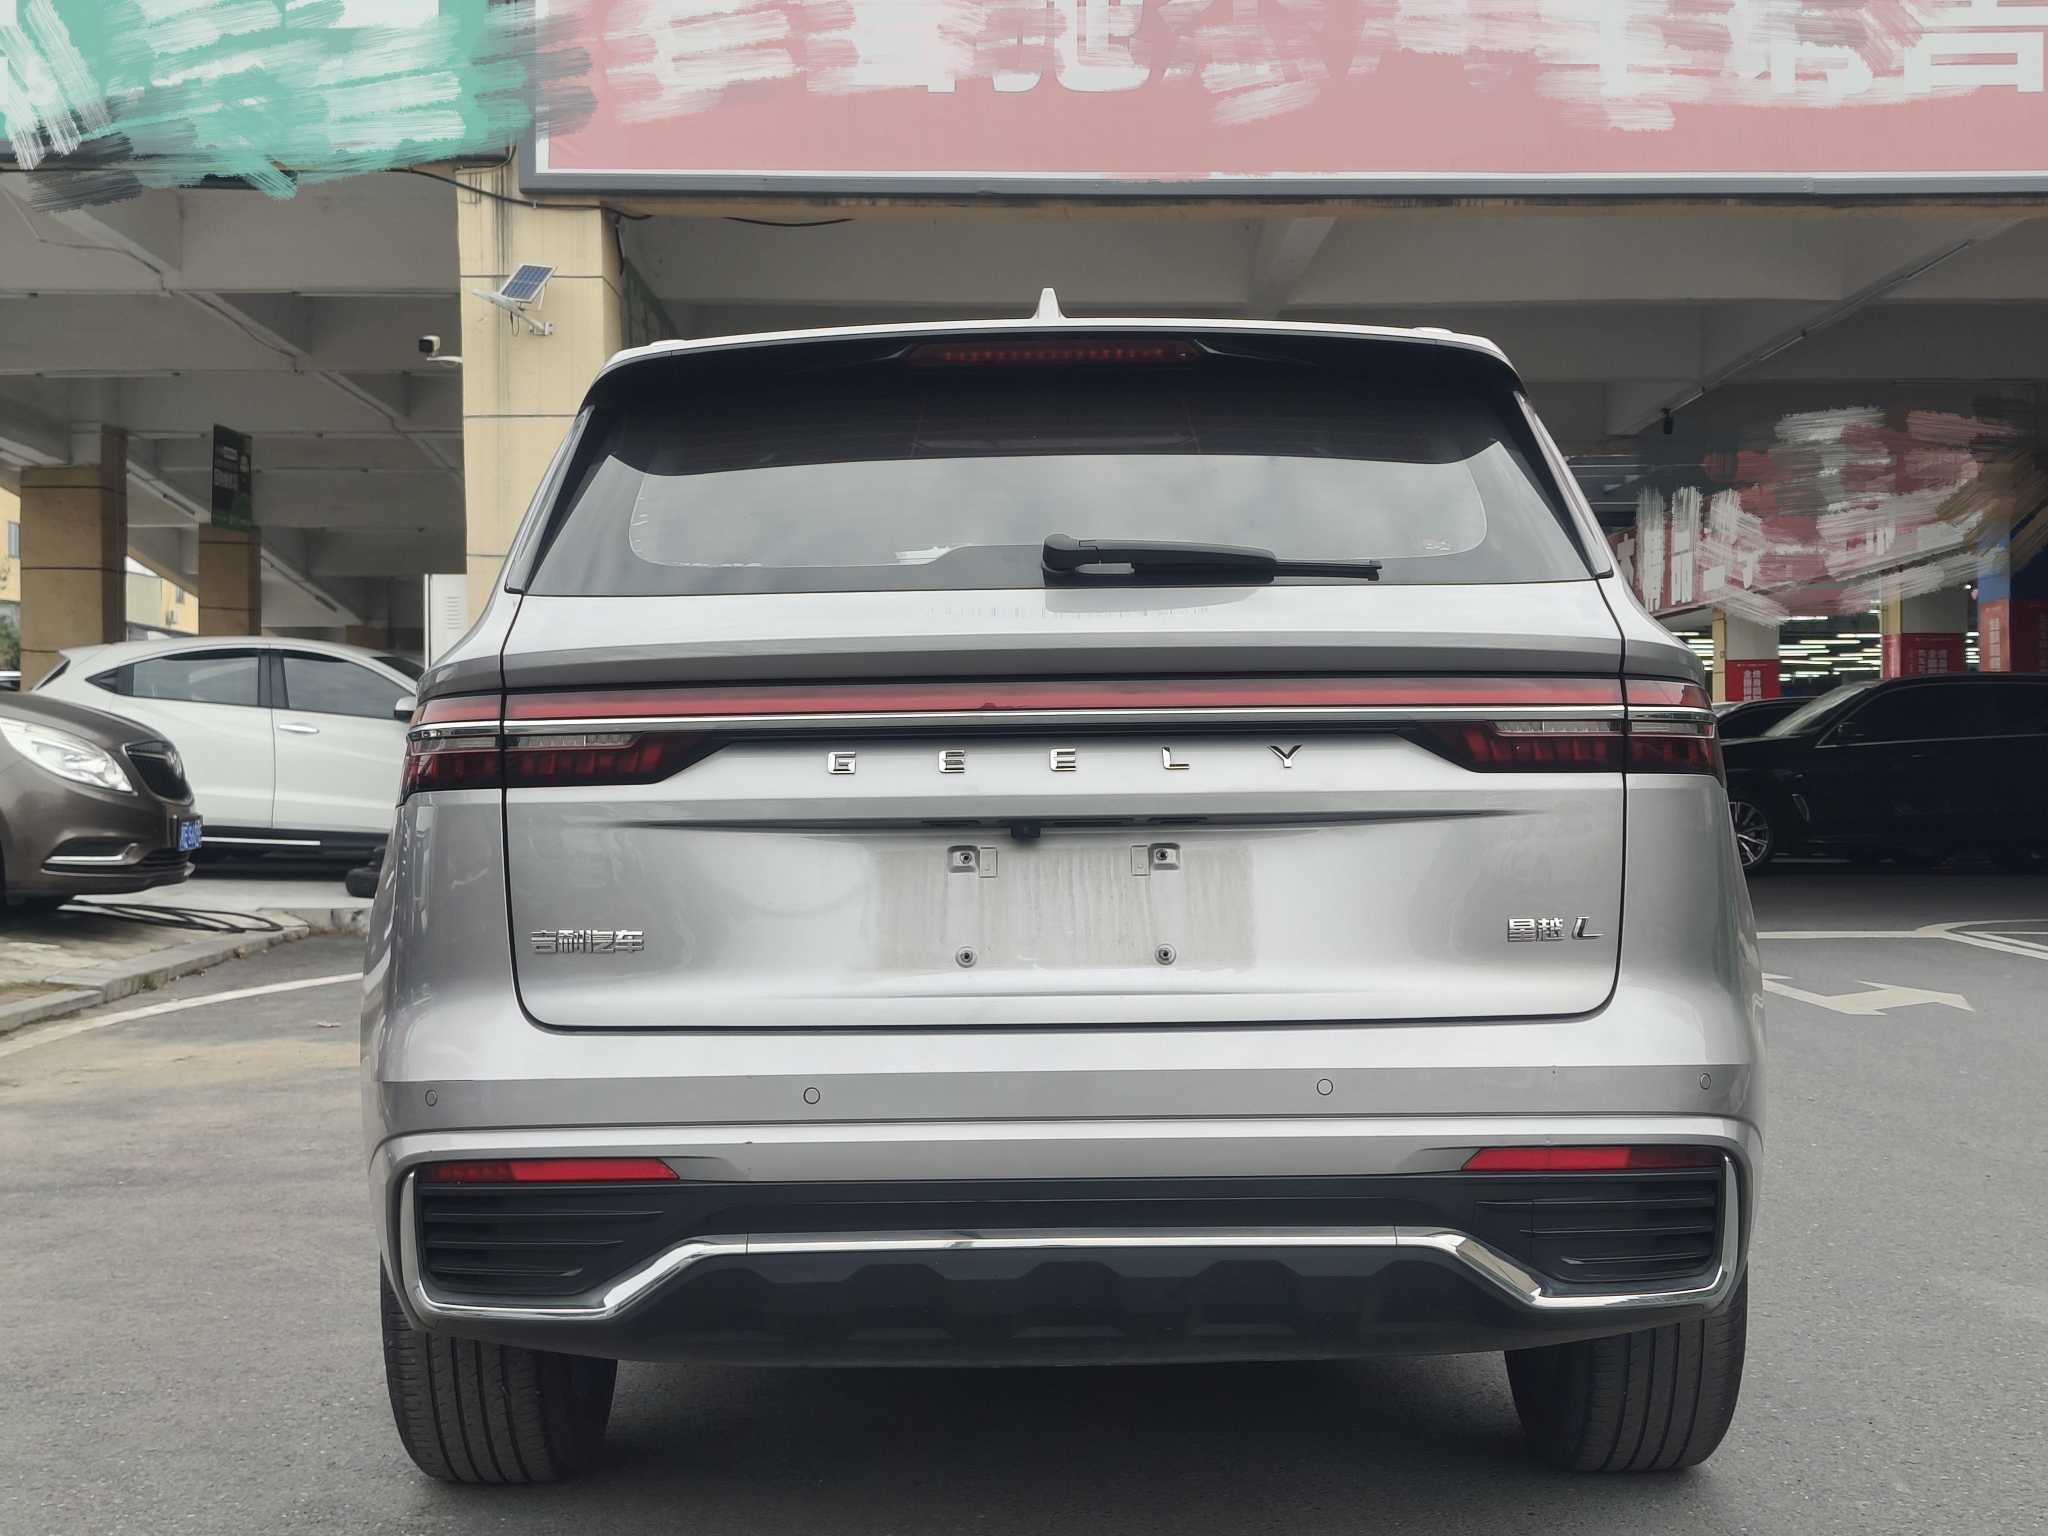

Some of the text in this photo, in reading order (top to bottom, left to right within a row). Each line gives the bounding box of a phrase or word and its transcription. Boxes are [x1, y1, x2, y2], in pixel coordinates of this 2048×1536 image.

[827, 745, 1302, 774] GEELY
[530, 929, 644, 953] 吉利汽车
[1508, 916, 1605, 942] 星越 L
